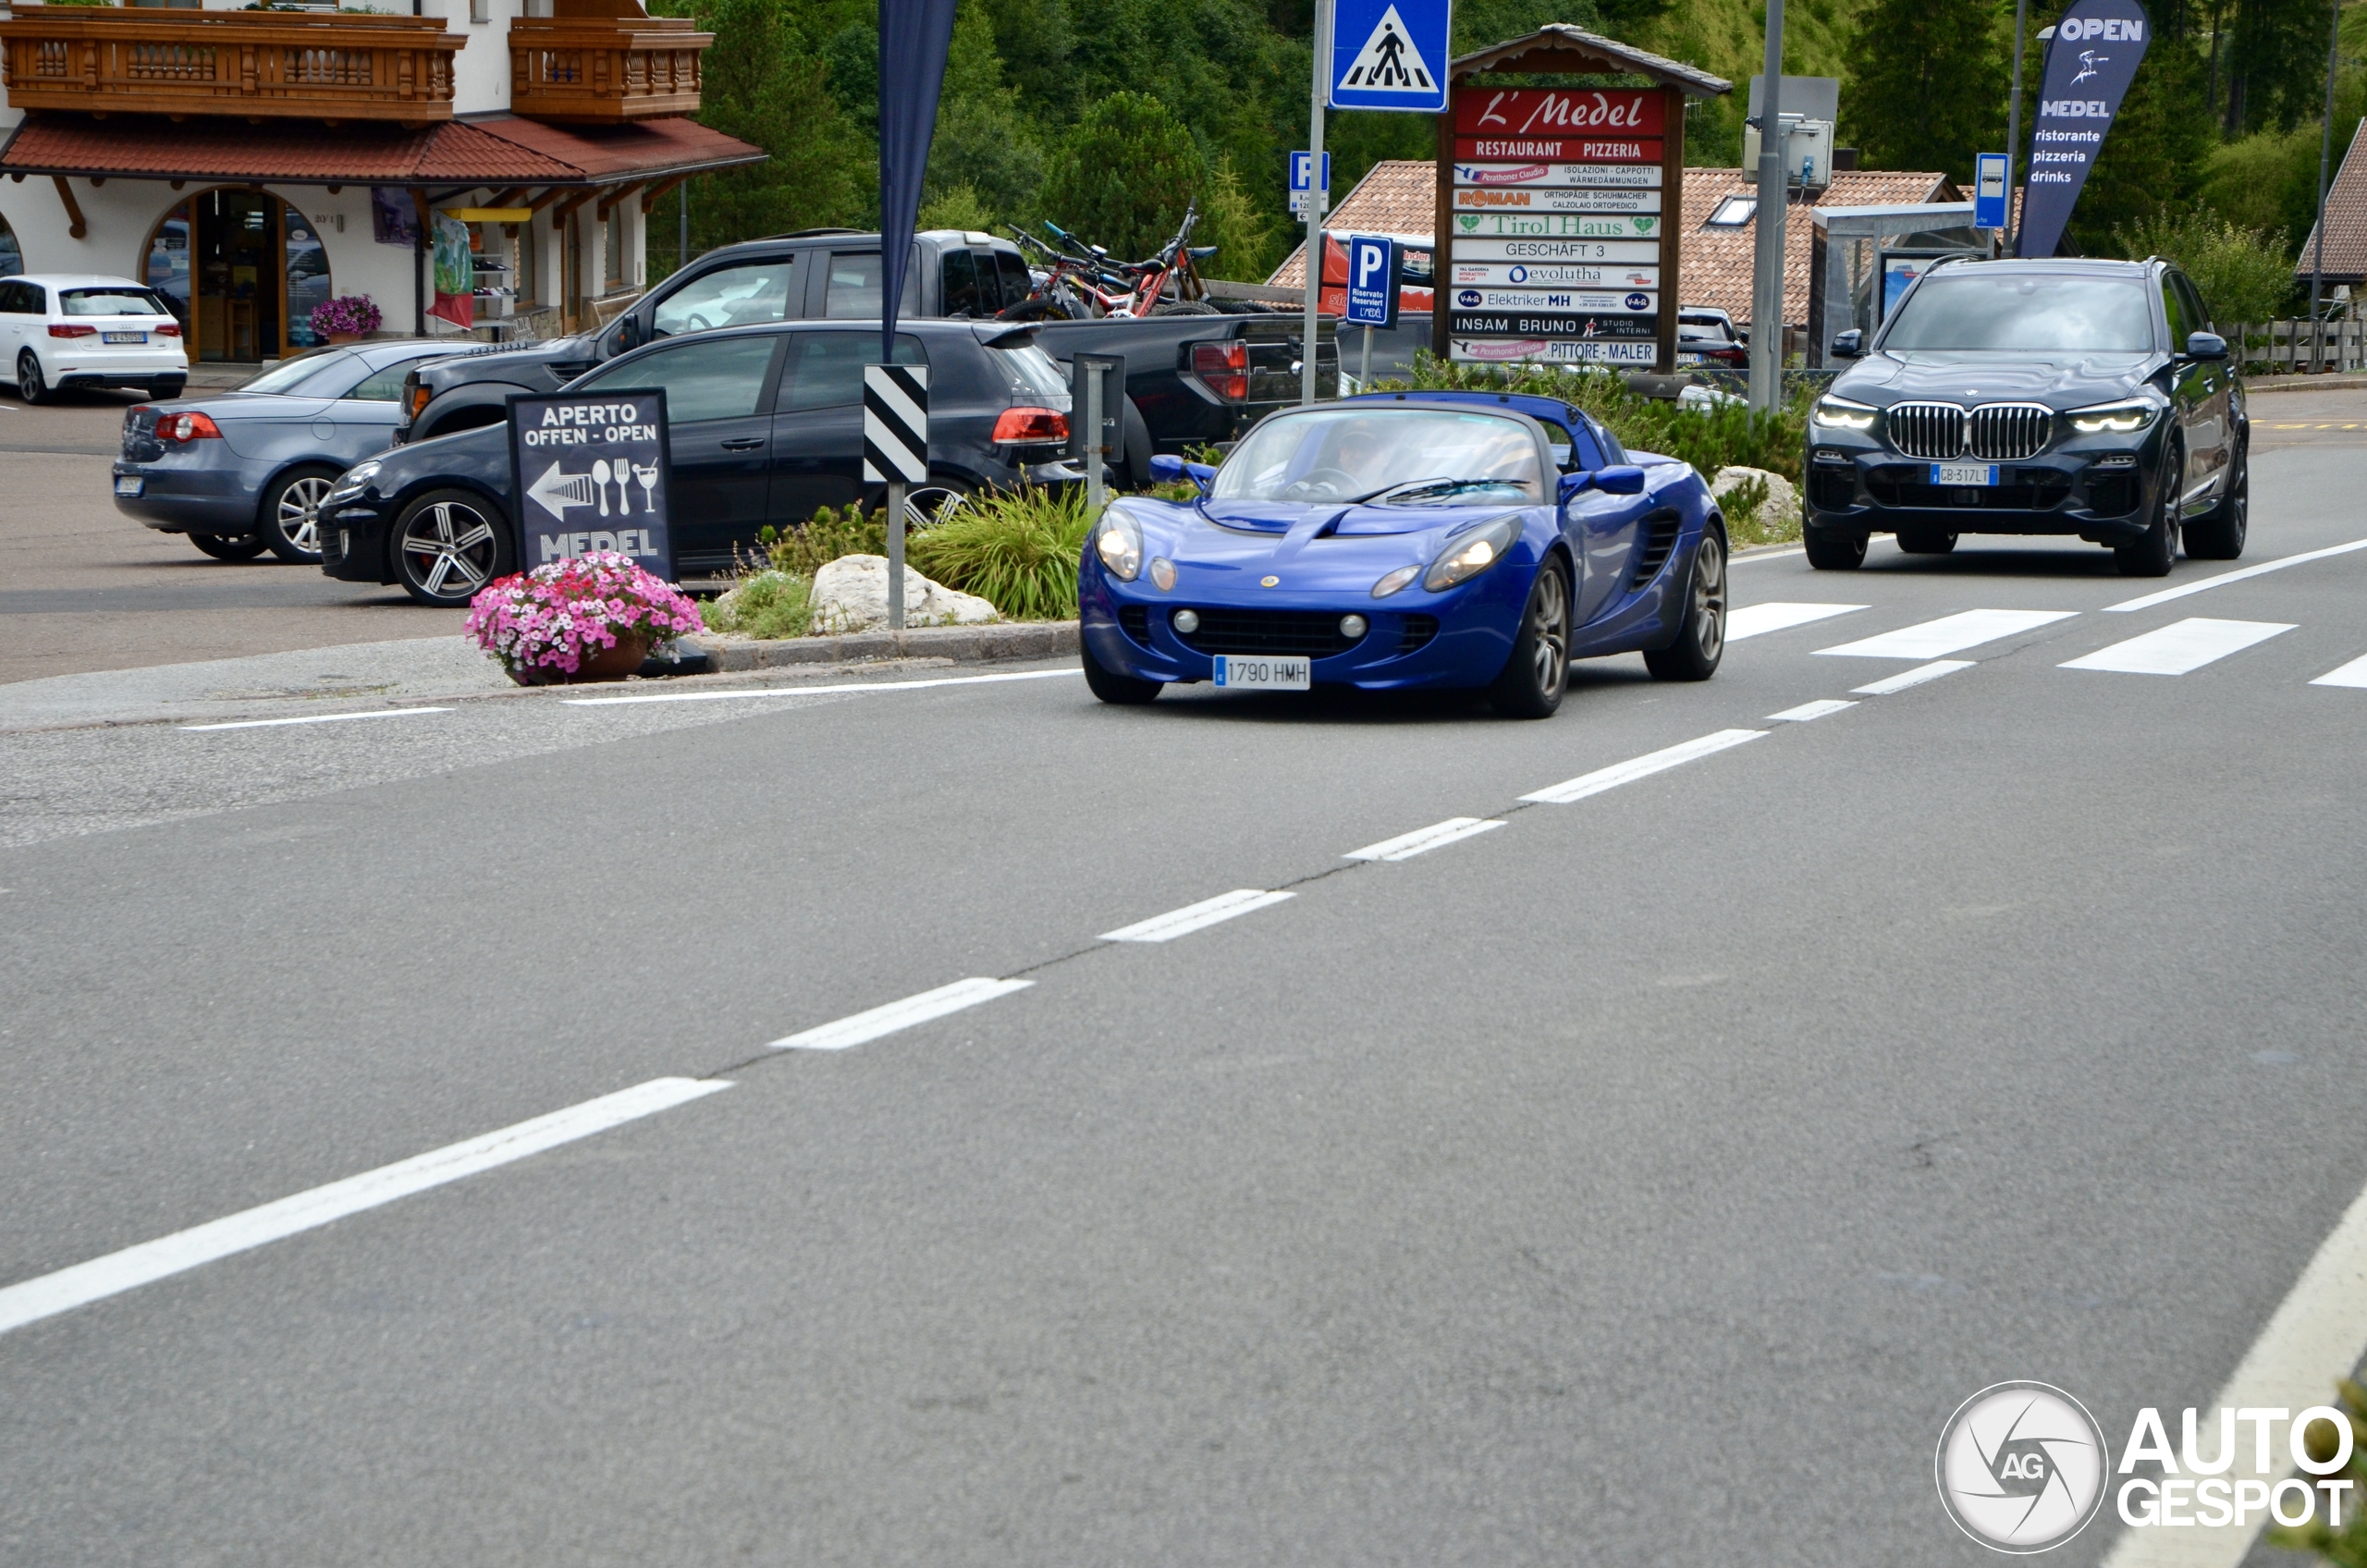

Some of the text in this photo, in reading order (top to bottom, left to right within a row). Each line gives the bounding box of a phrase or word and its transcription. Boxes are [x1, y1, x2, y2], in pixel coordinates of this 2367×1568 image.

[2060, 18, 2142, 41] OPEN
[2042, 100, 2109, 117] MEDEL
[2035, 129, 2100, 141] ristorante
[1476, 141, 1641, 157] RESTAURANT PIZZERIA
[2033, 150, 2086, 164] pizzeria
[1482, 167, 1544, 181] Perathoner Claudio
[1570, 175, 1649, 184] WÄRMEDÄMMUNGEN
[2030, 170, 2071, 182] drinks
[1459, 190, 1530, 207] ROMAN
[1544, 190, 1647, 200] ORTHOPÄDIE SCHUHMACHER
[1490, 215, 1623, 235] Tirol Haus
[1404, 251, 1429, 261] inder
[1505, 242, 1605, 257] GESCHÄFT 3
[1359, 245, 1382, 288] P
[1529, 266, 1600, 279] evolutha
[1353, 288, 1383, 299] Riservato
[1489, 294, 1570, 306] Elektriker MH
[1352, 297, 1382, 306] Reserviert
[1456, 318, 1576, 332] INSAM BRUNO
[1551, 343, 1600, 359] PITTORE
[1609, 344, 1651, 360] MALER
[1677, 353, 1698, 361] 66TW
[542, 404, 636, 426] APERTO
[525, 428, 586, 446] OFFEN
[605, 425, 656, 442] OPEN
[540, 529, 657, 561] MEDEL
[1229, 663, 1306, 682] 1790 HMH
